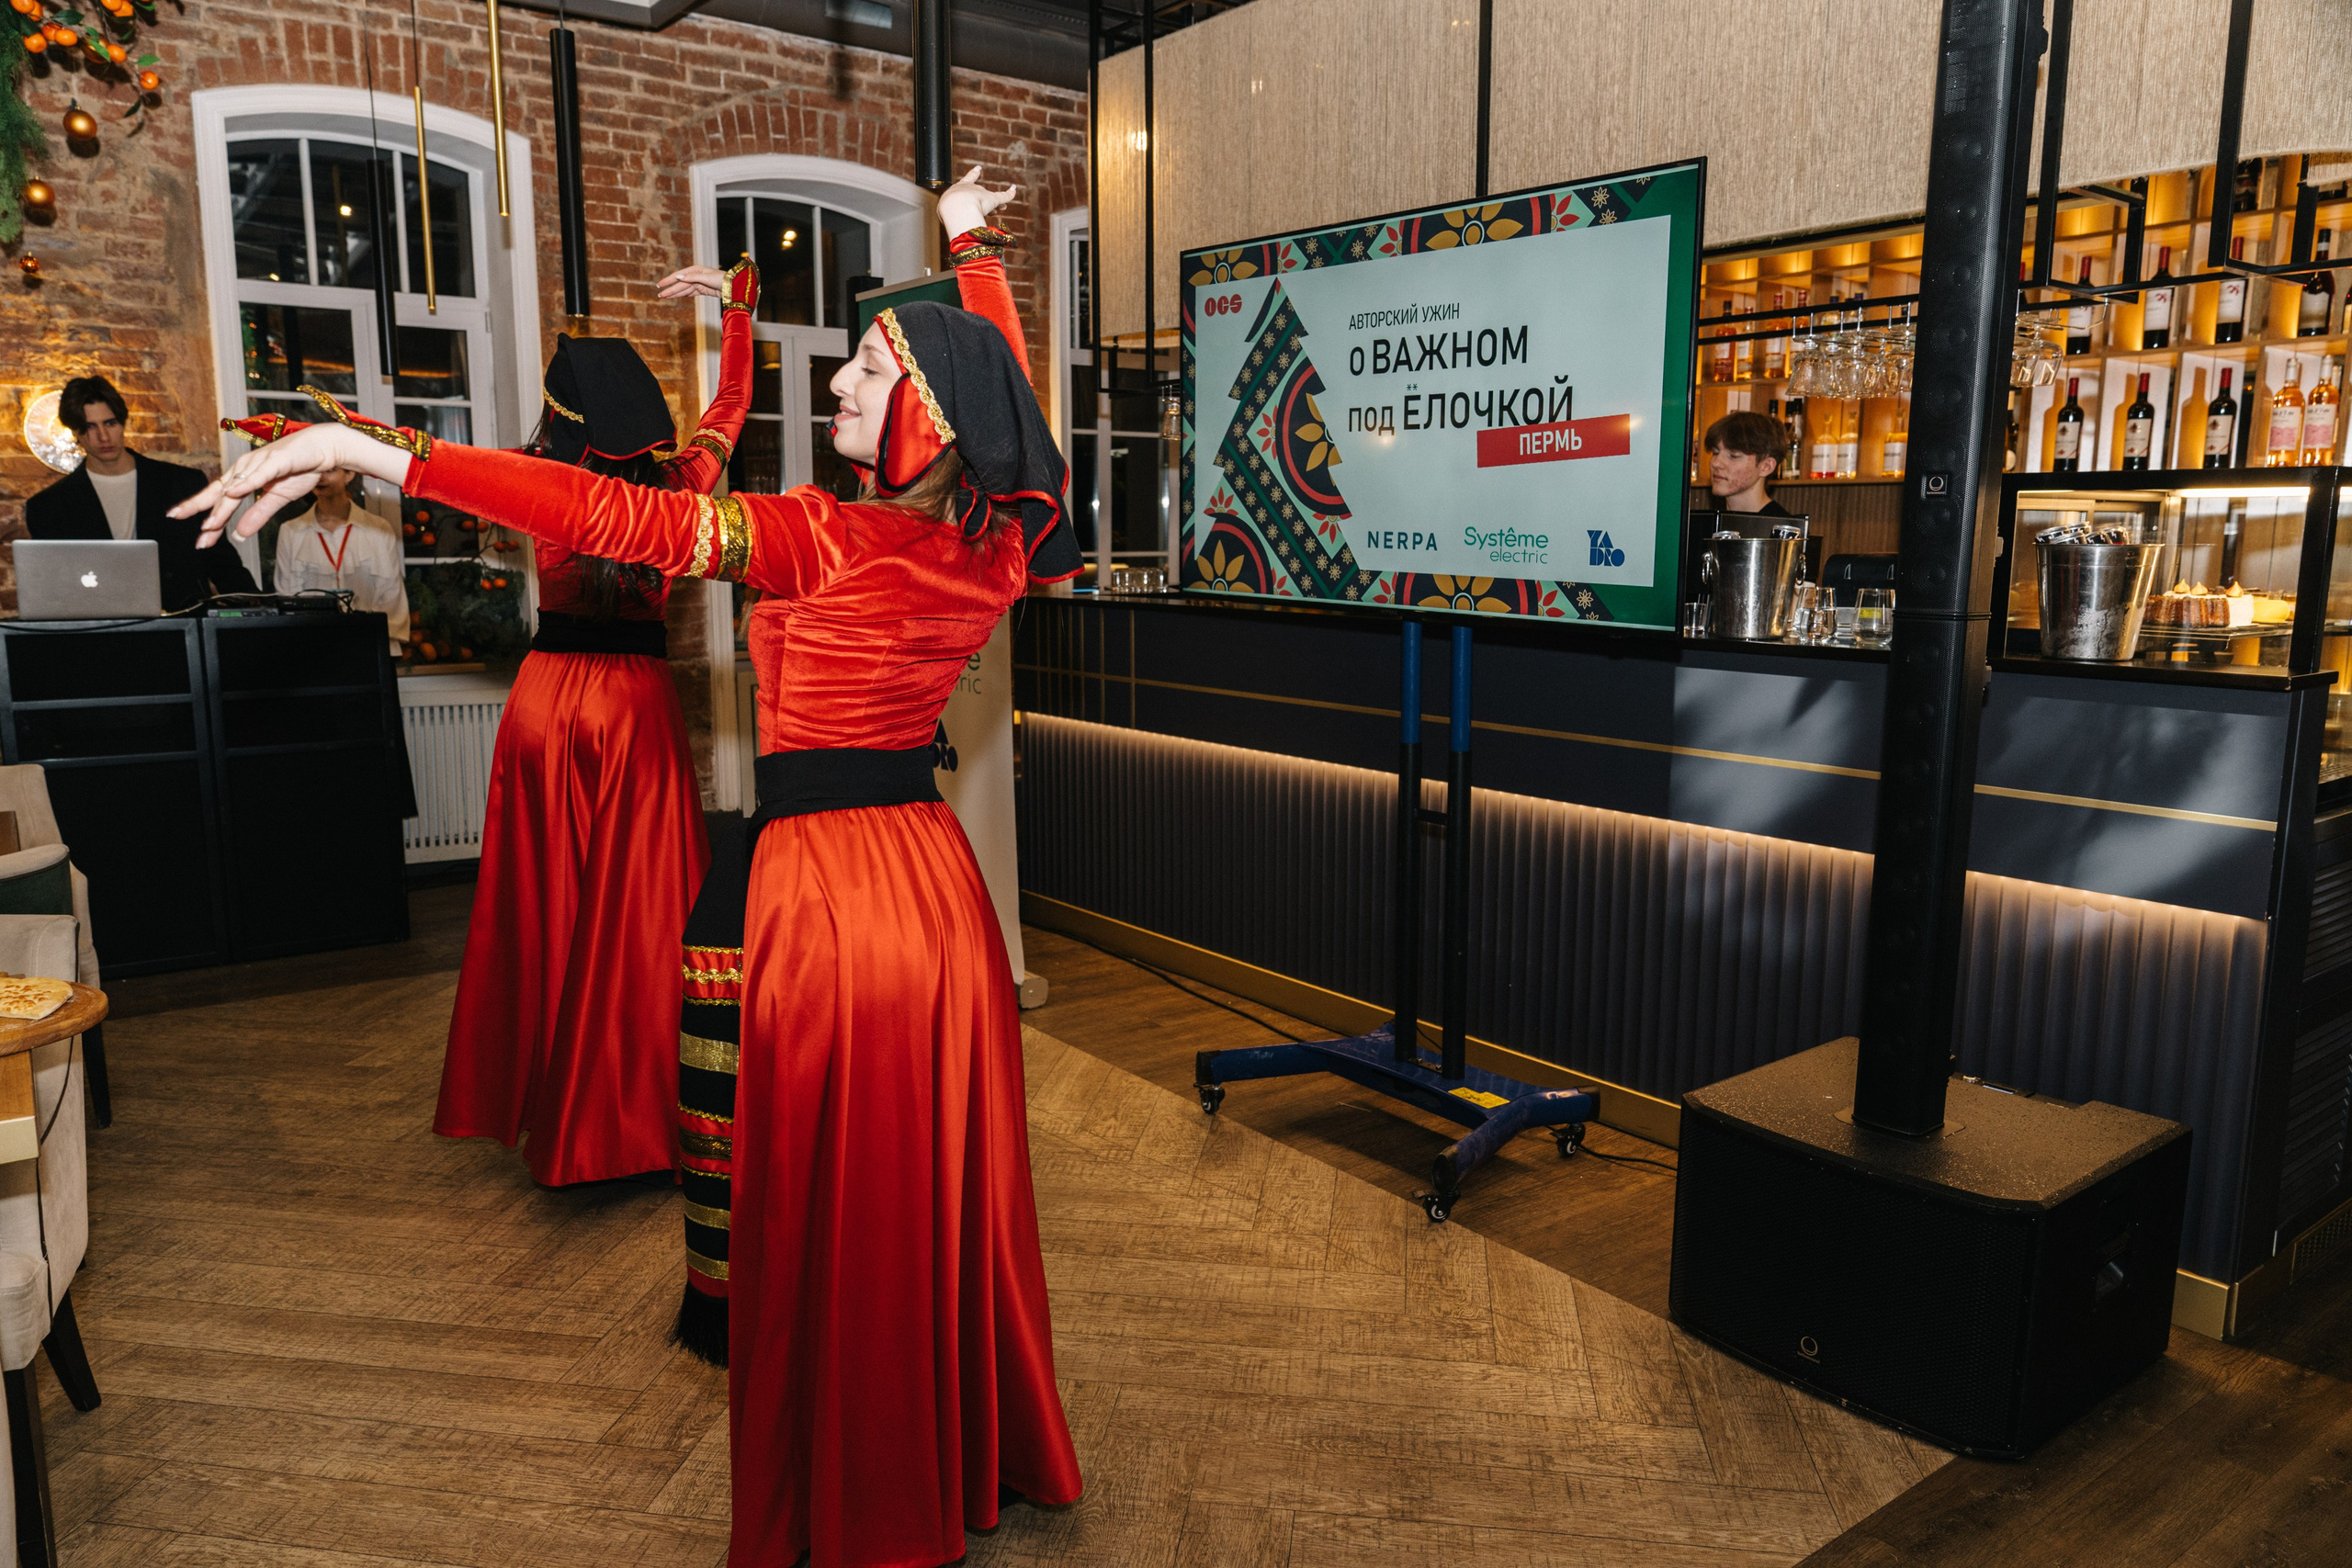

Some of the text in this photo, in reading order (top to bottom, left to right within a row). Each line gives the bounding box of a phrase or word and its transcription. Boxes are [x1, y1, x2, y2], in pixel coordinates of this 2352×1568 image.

[1204, 294, 1242, 317] OCS
[1349, 302, 1460, 331] АВТОРСКИЙ УЖИН
[1373, 325, 1528, 375] ВАЖНОМ
[1404, 375, 1573, 430] ЁЛОЧКОЙ
[1520, 428, 1583, 456] ПЕРМЬ
[1367, 531, 1438, 551] NERPA
[1464, 526, 1549, 550] Systême
[1489, 547, 1548, 565] electric
